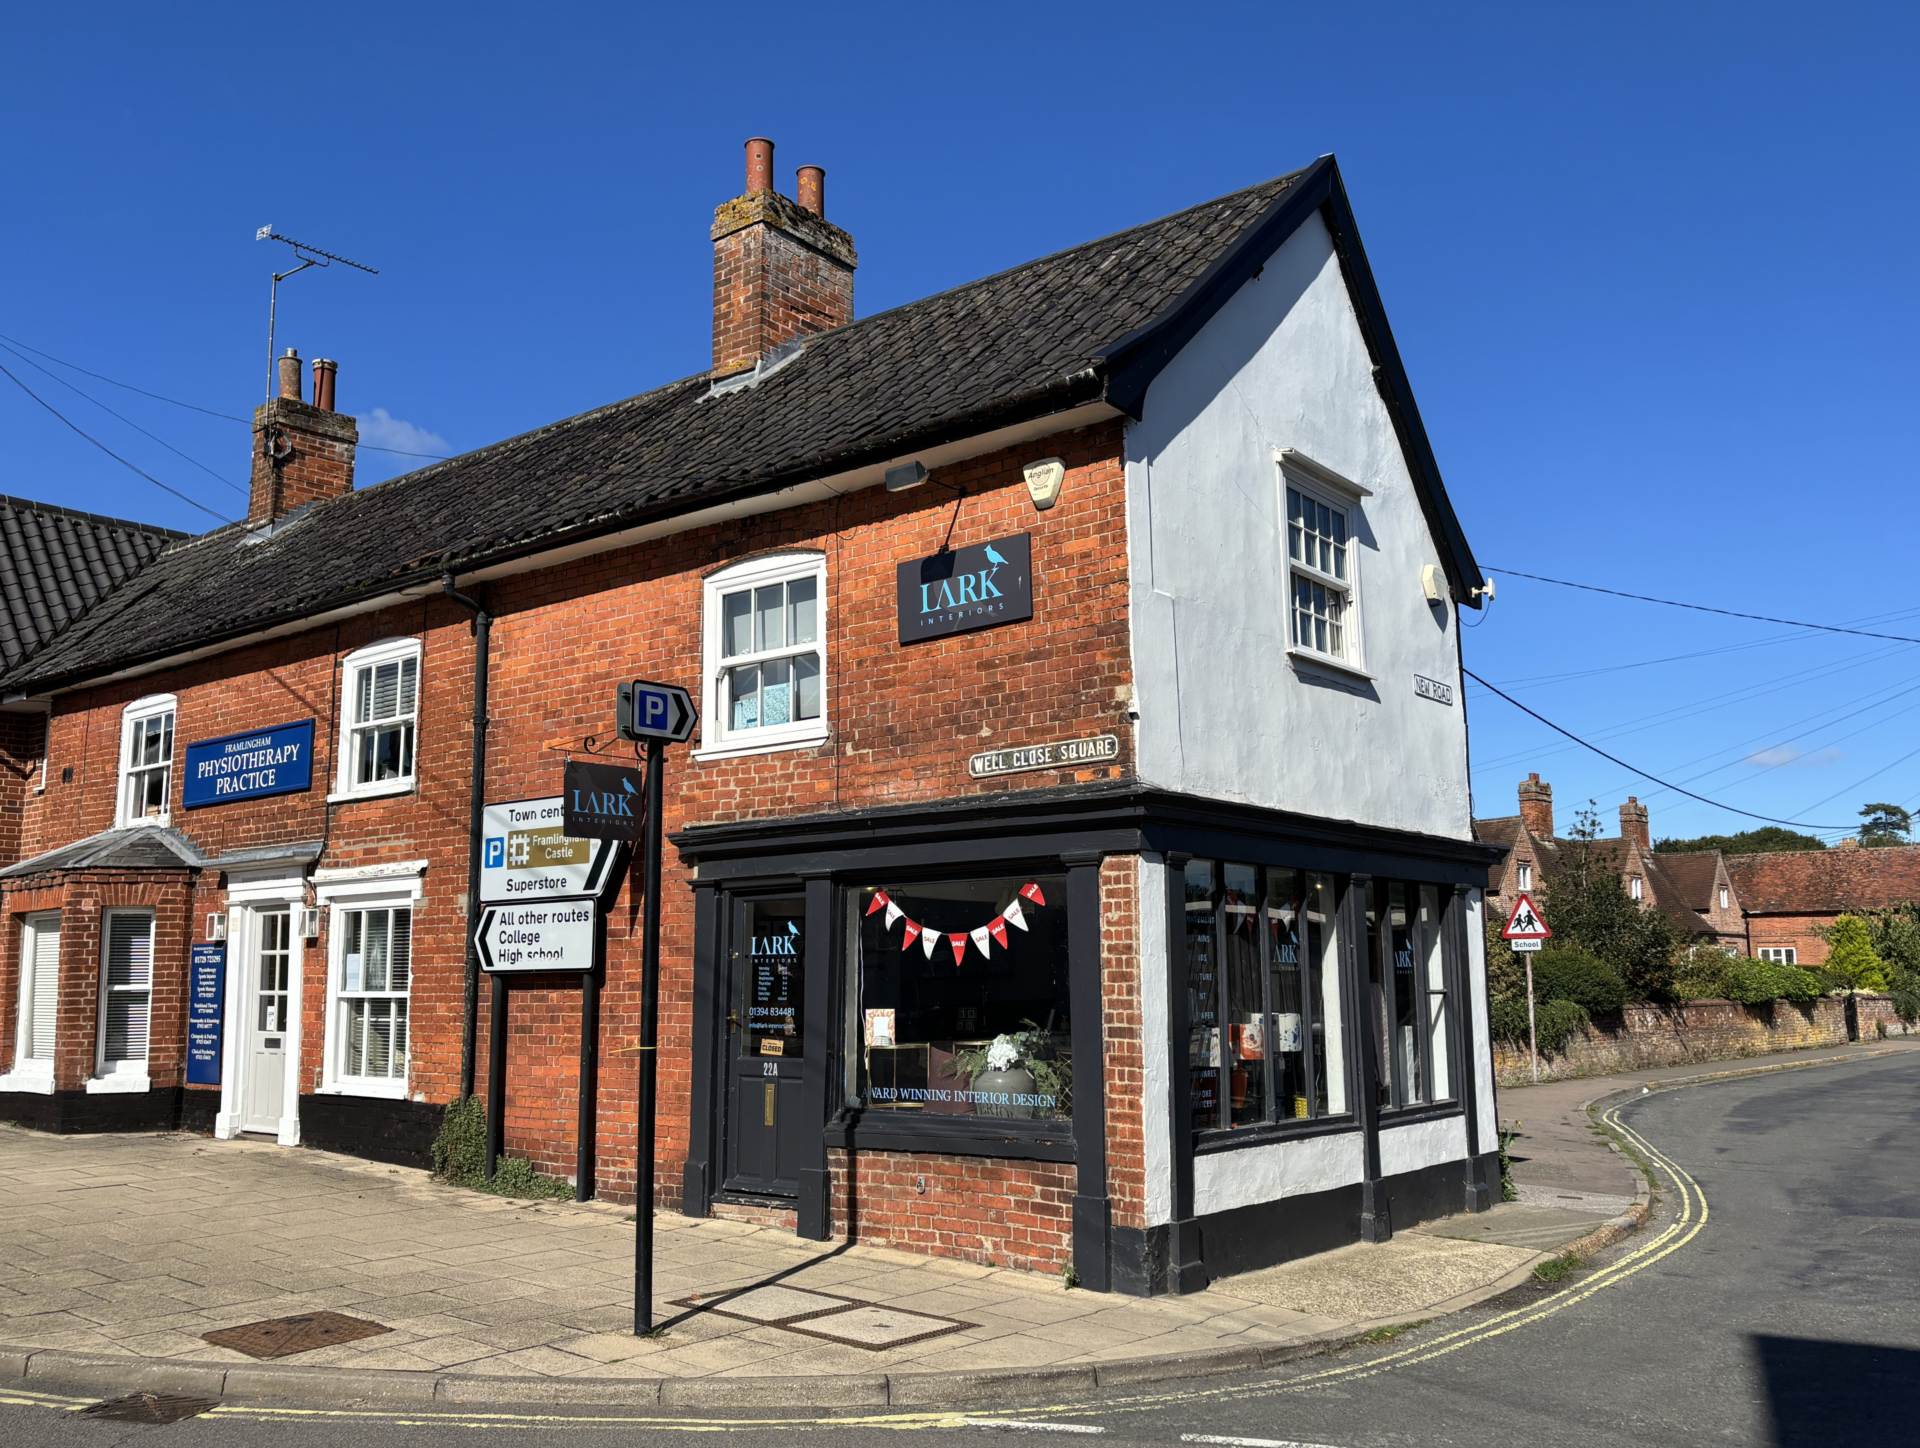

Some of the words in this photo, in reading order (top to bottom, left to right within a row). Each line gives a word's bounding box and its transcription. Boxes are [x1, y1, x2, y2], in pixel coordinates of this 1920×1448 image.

[920, 567, 1004, 614] LARK
[920, 603, 1004, 626] INTERIORS
[1415, 677, 1429, 695] NEW
[1433, 683, 1450, 701] ROAD
[225, 736, 272, 753] FRAMLINGHAM
[198, 744, 300, 778] PHYSIOTHERAPY
[974, 755, 1008, 773] WELL
[1013, 748, 1053, 767] CLOSE
[1060, 739, 1114, 760] SQUARE
[216, 769, 276, 794] PRACTICE
[572, 789, 634, 817] LARK
[509, 809, 537, 822] Town
[540, 804, 565, 819] cent
[572, 816, 635, 827] INTERIORS
[545, 846, 573, 859] Castle
[506, 876, 567, 893] Superstore
[1027, 883, 1039, 898] SALE
[500, 912, 514, 926] All
[518, 910, 548, 925] other
[552, 908, 589, 923] routes
[499, 930, 540, 945] College
[906, 925, 918, 936] SALE
[992, 923, 1005, 935] SALE
[751, 935, 797, 955] LARK
[924, 936, 935, 944] SALE
[975, 934, 987, 943] SALE
[499, 948, 523, 965] High
[1273, 944, 1297, 963] ARK
[1395, 951, 1412, 967] ARK
[749, 1007, 769, 1016] 01394
[770, 1007, 795, 1017] 834481
[762, 1044, 782, 1053] CLOSED
[763, 1062, 778, 1076] 22A
[862, 1087, 898, 1099] AWARD
[900, 1087, 951, 1101] WINNING
[954, 1089, 1009, 1105] INTERIOR
[1012, 1092, 1056, 1108] DESIGN
